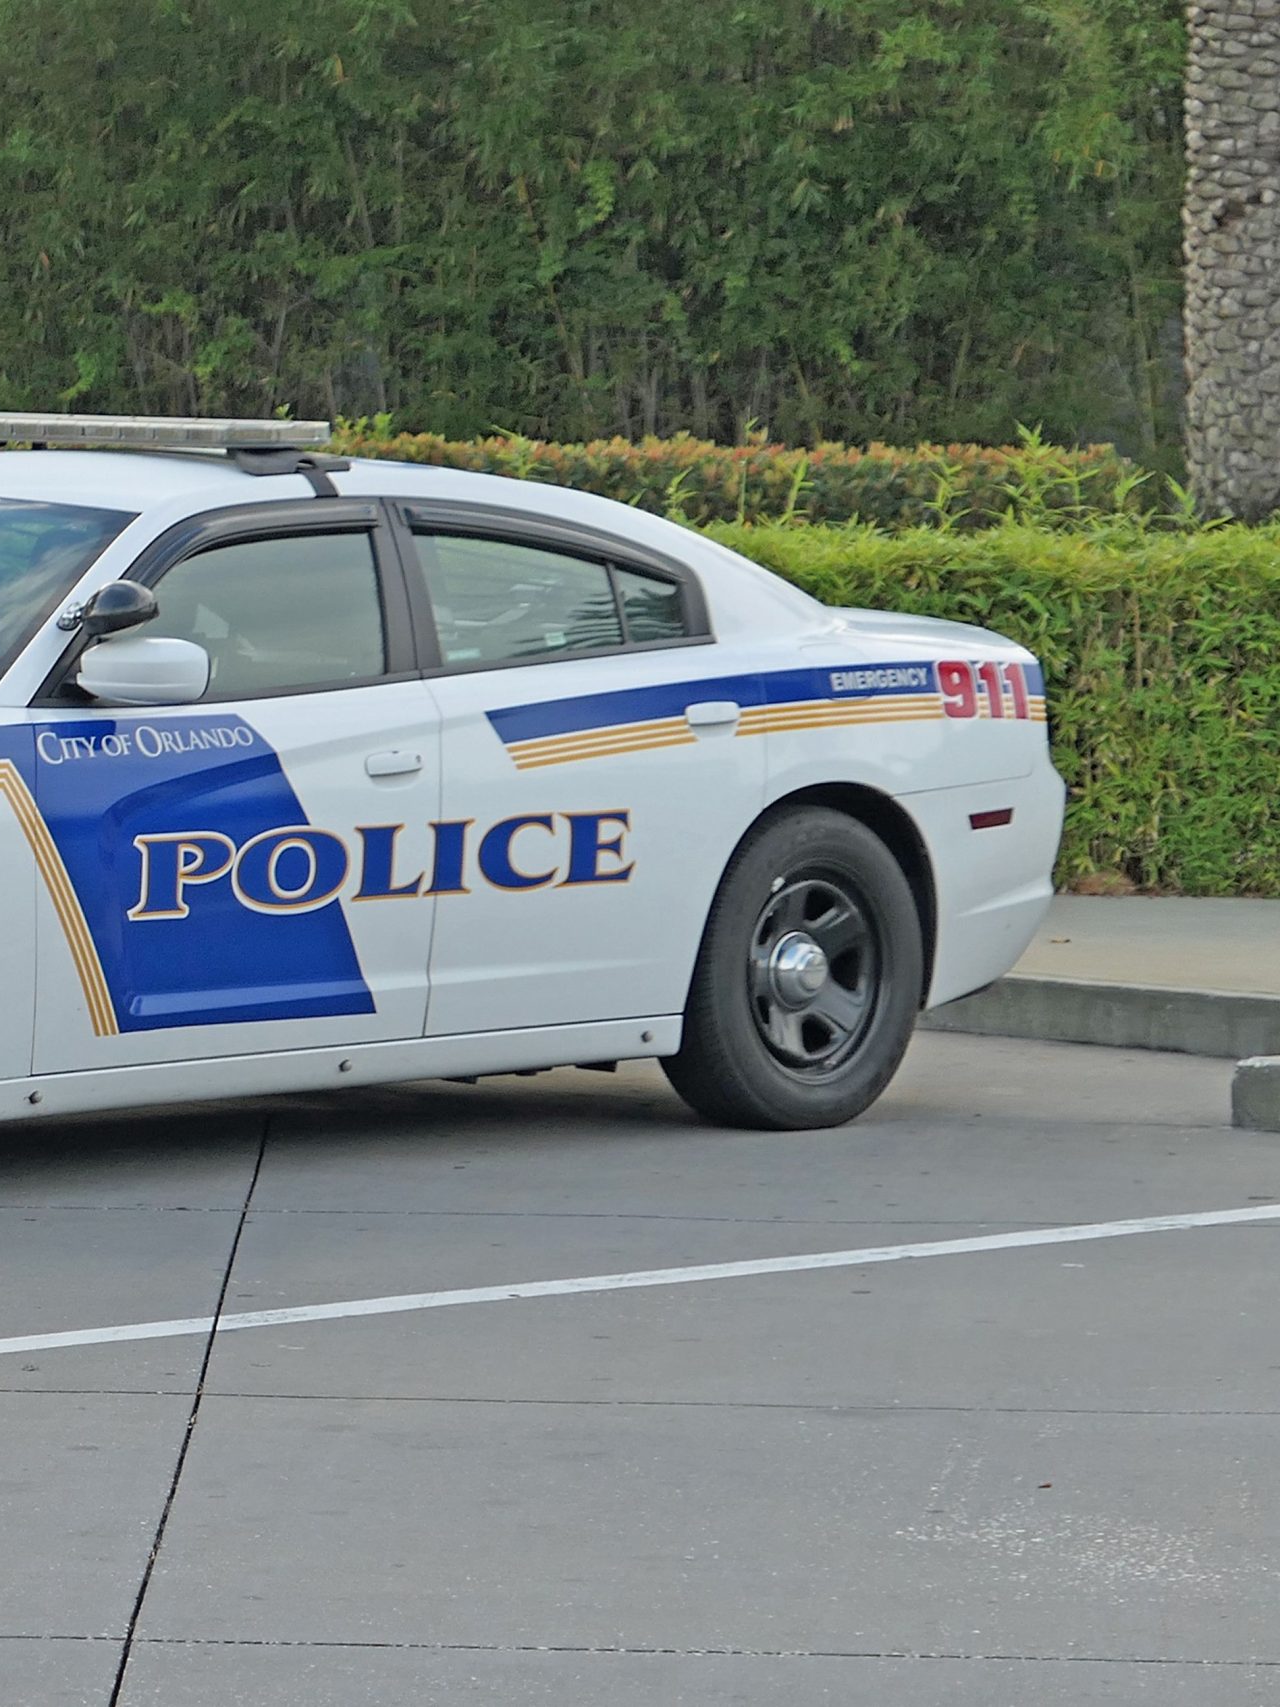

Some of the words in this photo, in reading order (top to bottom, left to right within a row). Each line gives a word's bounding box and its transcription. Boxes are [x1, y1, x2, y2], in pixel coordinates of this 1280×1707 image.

[829, 668, 928, 691] EMERGENCY
[935, 659, 1030, 720] 911
[127, 808, 636, 921] POLICE
